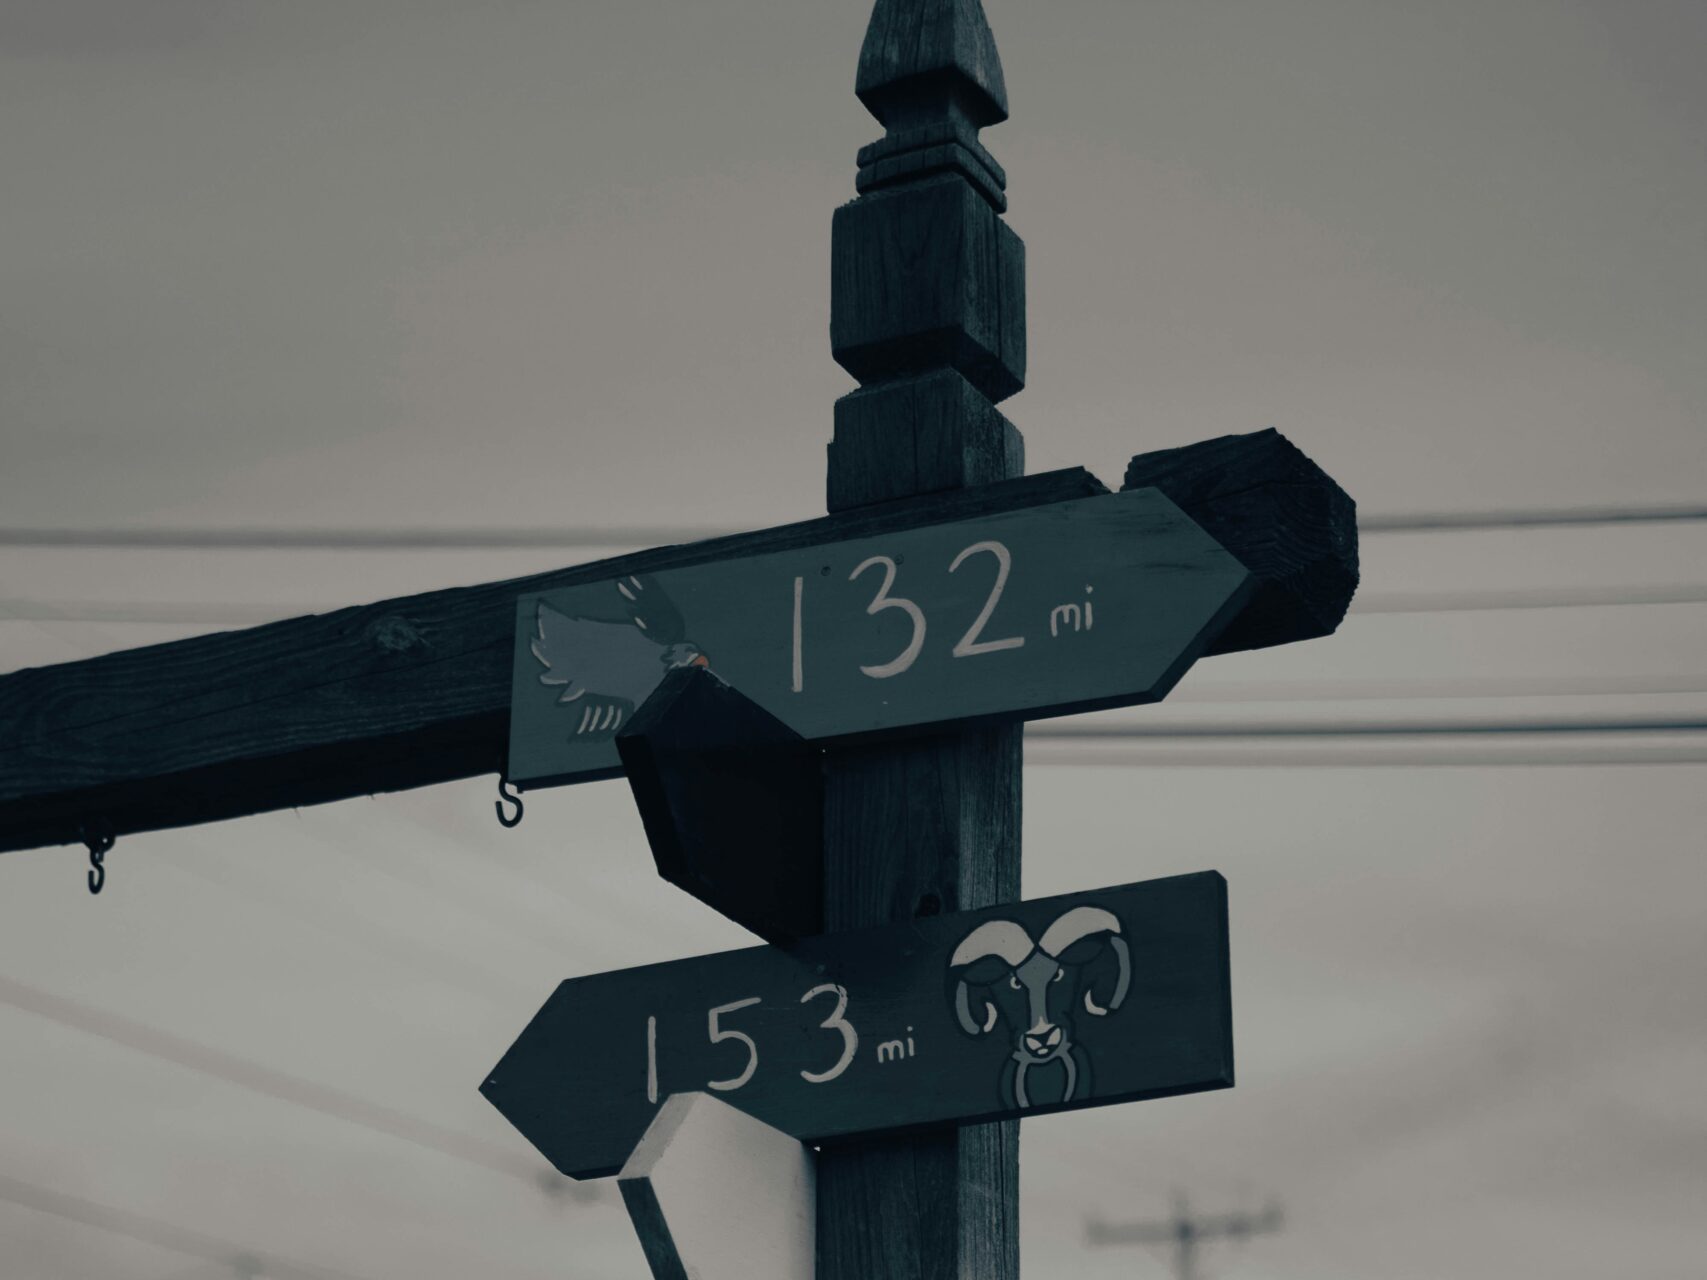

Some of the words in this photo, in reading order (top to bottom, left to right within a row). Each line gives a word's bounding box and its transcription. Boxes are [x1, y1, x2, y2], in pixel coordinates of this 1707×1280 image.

[791, 540, 1025, 693] 132
[1050, 584, 1094, 638] mi
[647, 983, 858, 1104] 153
[877, 1026, 915, 1064] mi
